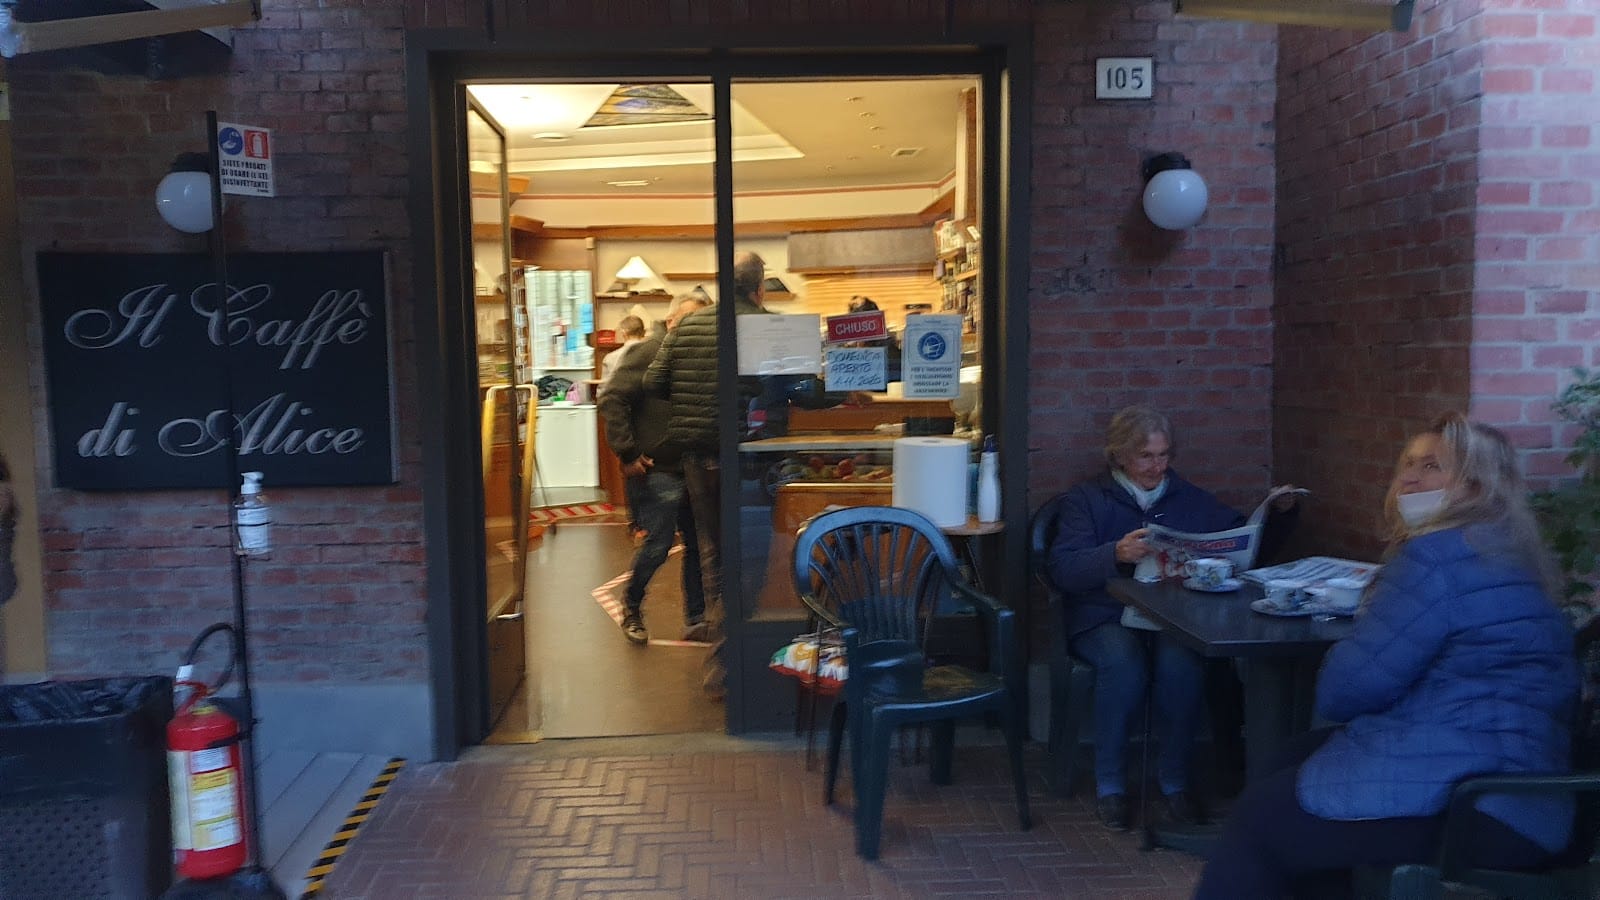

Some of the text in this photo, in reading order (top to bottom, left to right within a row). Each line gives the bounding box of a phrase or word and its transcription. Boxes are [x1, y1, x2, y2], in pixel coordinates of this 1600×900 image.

[1106, 66, 1143, 90] 105
[222, 159, 240, 168] SIETE
[221, 168, 229, 176] DI
[230, 170, 249, 178] USARE
[222, 178, 268, 189] DISINFETTANTE
[64, 282, 374, 370] Il Caffè
[835, 320, 876, 336] CHIUSO
[77, 392, 366, 457] di Alice
